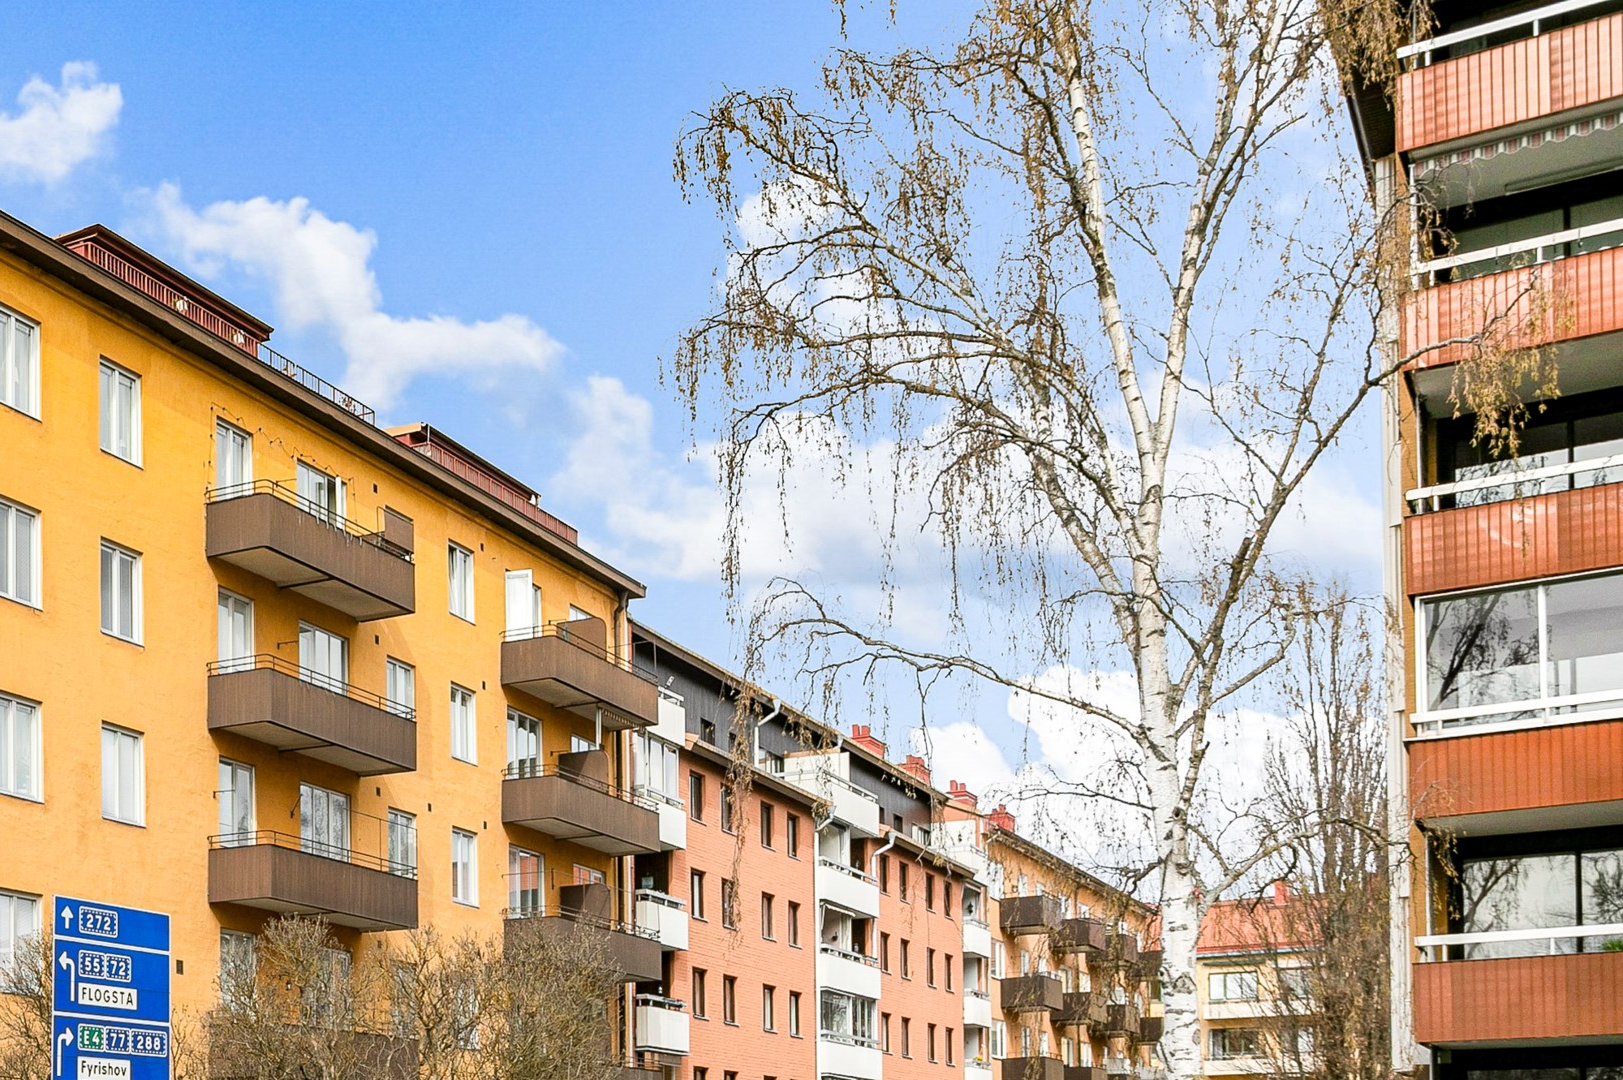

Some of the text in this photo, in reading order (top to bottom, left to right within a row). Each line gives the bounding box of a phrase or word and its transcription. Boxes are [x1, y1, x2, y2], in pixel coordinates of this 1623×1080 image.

[86, 915, 111, 931] 272
[85, 957, 126, 976] 55 72
[81, 987, 133, 1006] FLOGSTA
[110, 1034, 126, 1048] 77
[137, 1035, 160, 1050] 288
[81, 1060, 127, 1078] Fyrishov
